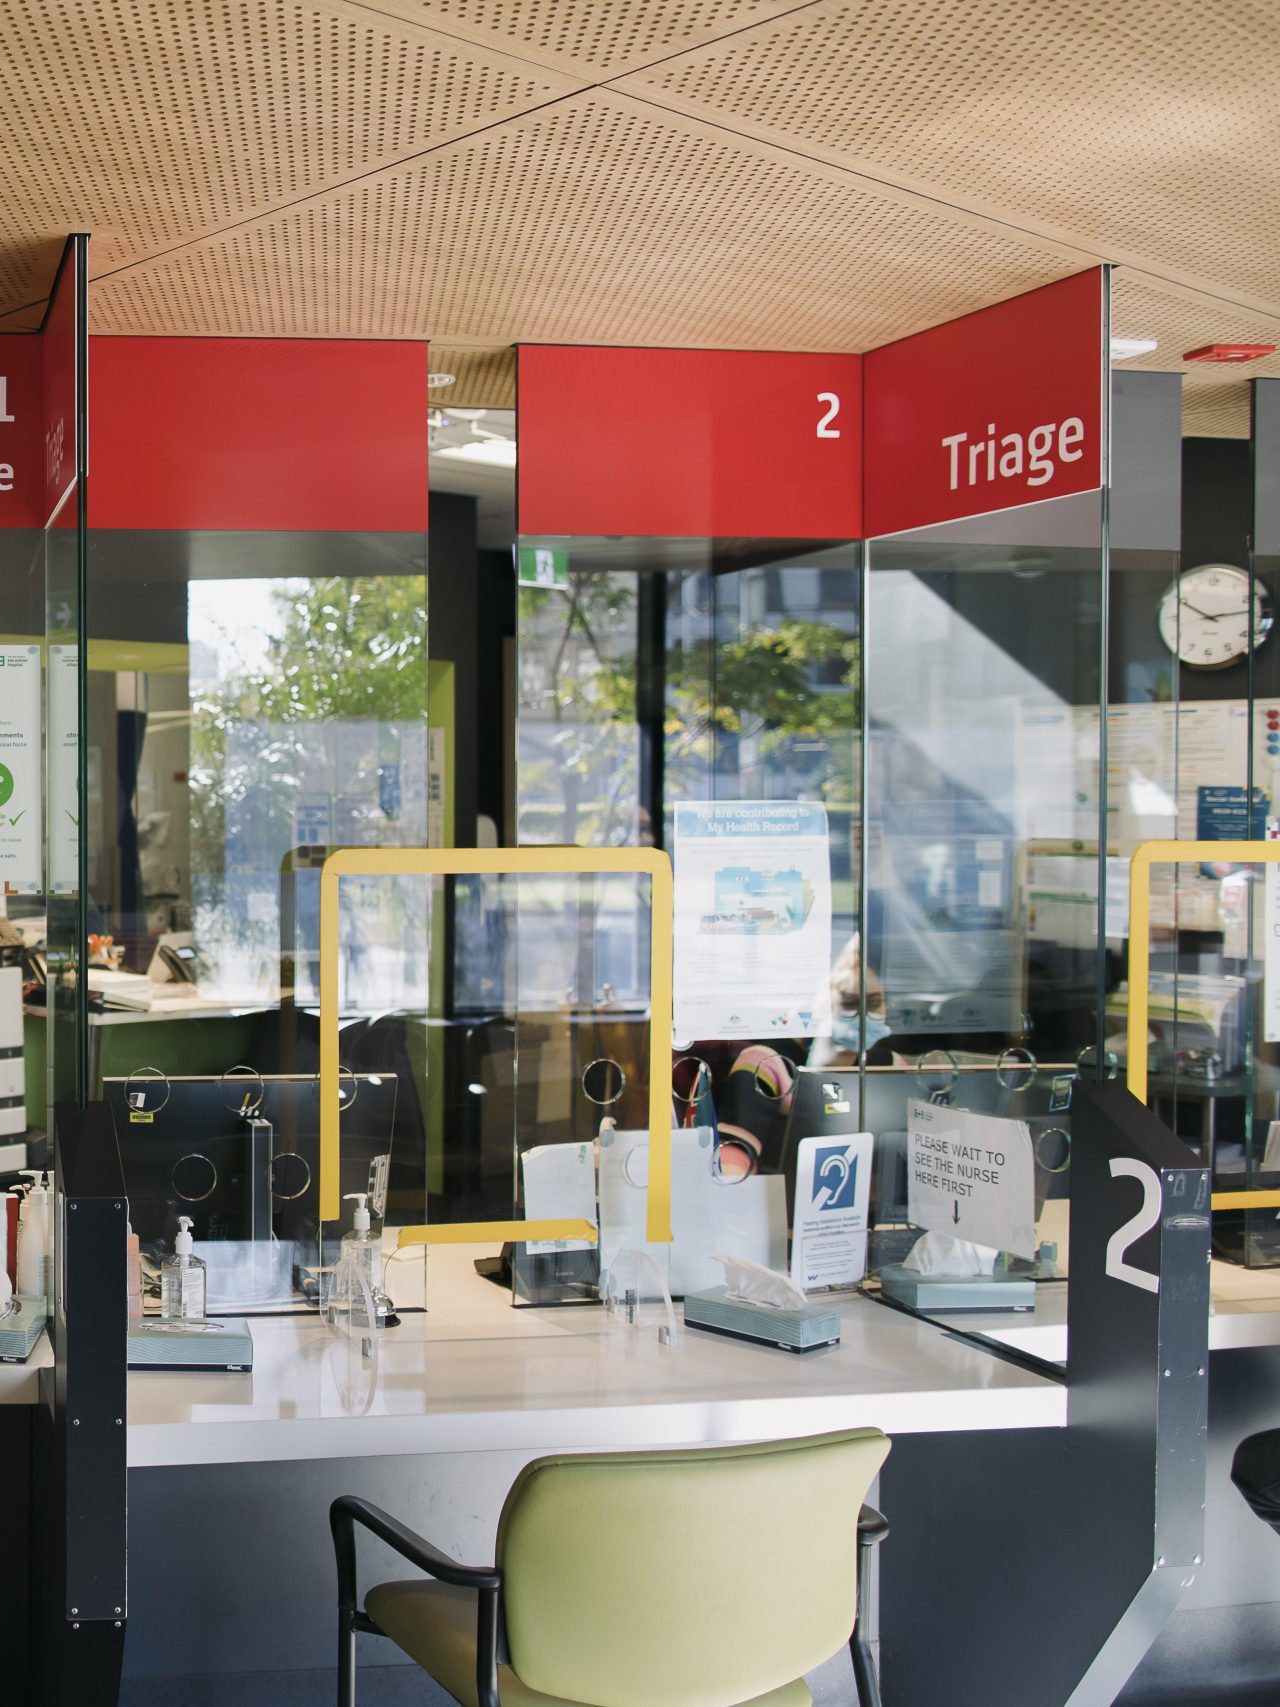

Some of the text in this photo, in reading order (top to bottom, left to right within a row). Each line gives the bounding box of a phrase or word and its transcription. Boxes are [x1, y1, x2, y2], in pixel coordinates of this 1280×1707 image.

[815, 391, 842, 439] 2
[45, 416, 65, 486] Triage
[941, 416, 1086, 491] Triage
[1204, 648, 1213, 657] 6
[1224, 643, 1232, 652] 5
[13, 741, 27, 749] force
[707, 821, 799, 833] My Health Record
[715, 808, 732, 818] are
[735, 808, 798, 820] contributing
[799, 808, 809, 818] to
[915, 1133, 1005, 1166] PLEASE WAIT TO
[915, 1152, 999, 1185] SEE THE NURSE
[915, 1169, 973, 1197] HERE FIRST
[1106, 1157, 1162, 1293] 2
